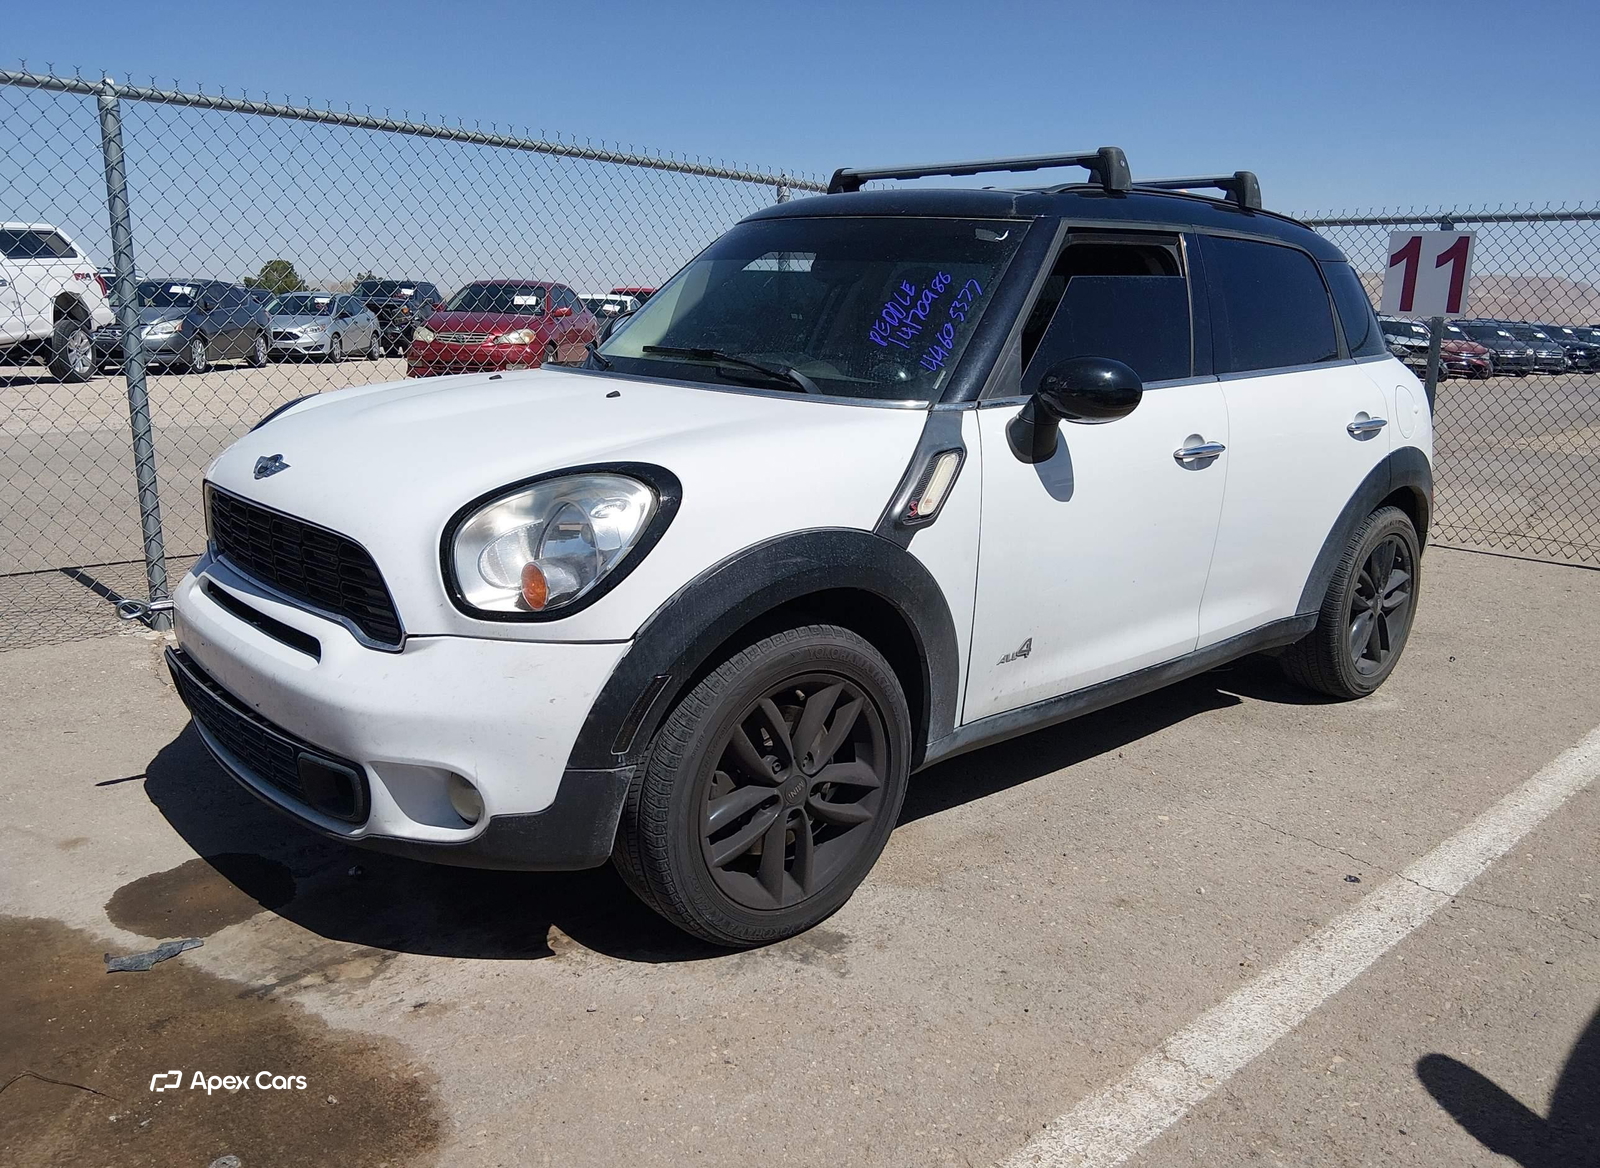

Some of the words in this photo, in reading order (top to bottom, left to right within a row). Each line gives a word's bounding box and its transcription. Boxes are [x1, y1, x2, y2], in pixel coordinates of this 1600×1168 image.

[1389, 236, 1470, 313] 11
[869, 280, 915, 346] PEDDLE
[788, 780, 805, 799] MINI
